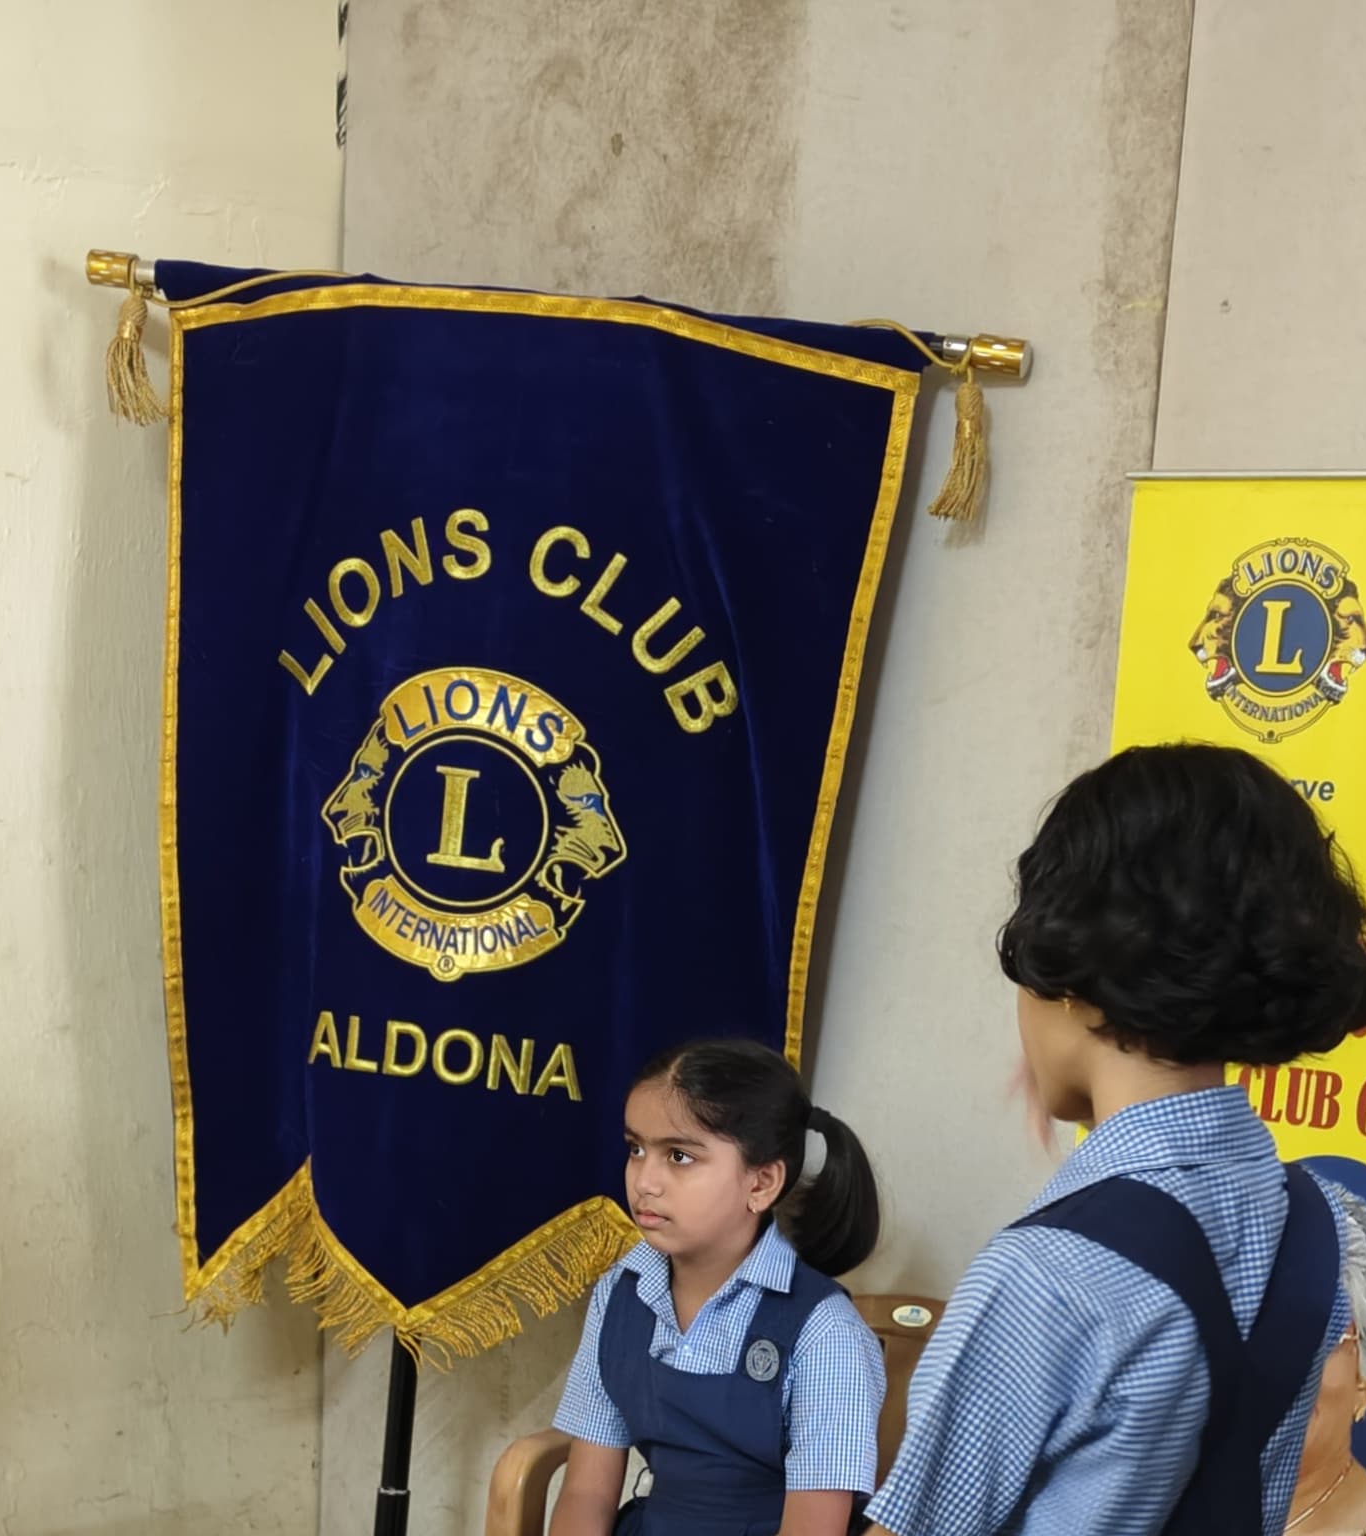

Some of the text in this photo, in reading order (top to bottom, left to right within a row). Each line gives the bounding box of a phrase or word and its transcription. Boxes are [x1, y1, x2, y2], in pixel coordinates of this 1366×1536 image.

[1242, 548, 1340, 590] LIONS
[278, 508, 739, 735] LIONS CLUB
[1255, 600, 1303, 675] L
[392, 677, 566, 756] LIONS
[426, 764, 506, 873] L
[1290, 779, 1335, 802] ve
[369, 887, 548, 956] INTERNATIONAL
[308, 1010, 583, 1101] ALDONA
